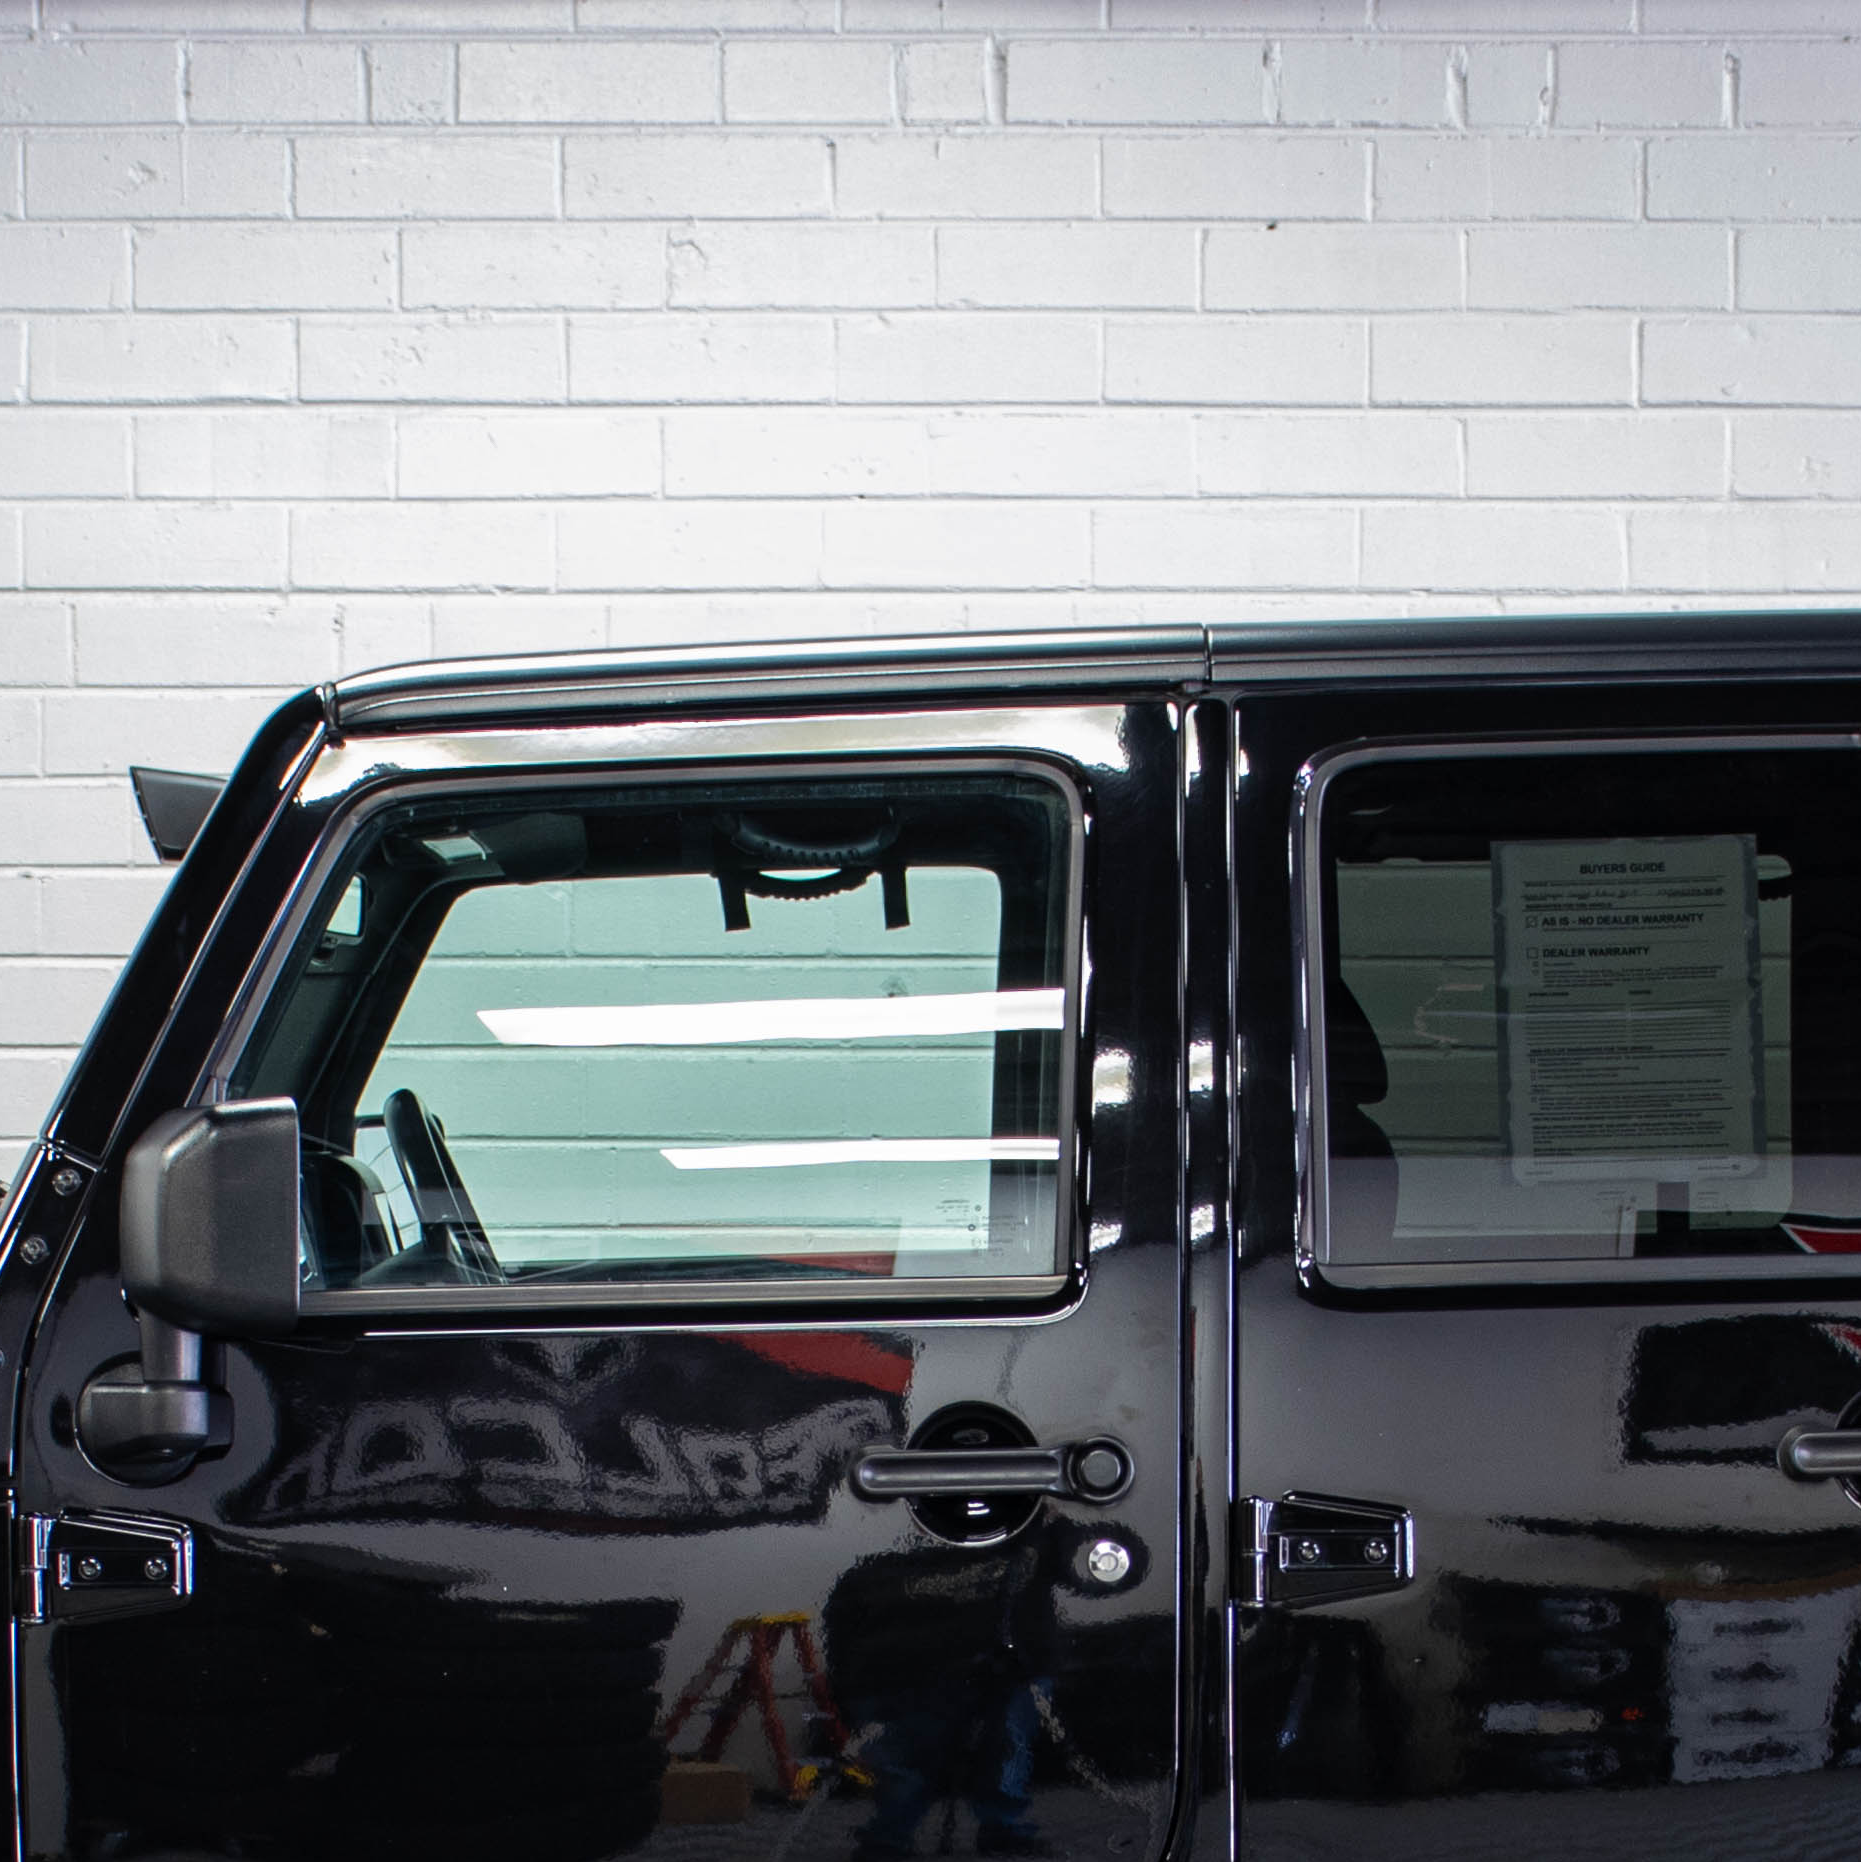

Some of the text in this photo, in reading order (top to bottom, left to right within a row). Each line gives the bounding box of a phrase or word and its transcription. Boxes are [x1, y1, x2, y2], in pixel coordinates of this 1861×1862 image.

[1579, 862, 1667, 874] BUYERS GUIDE
[1541, 916, 1557, 926] AS
[1559, 916, 1570, 926] IS
[1578, 915, 1594, 926] NO
[1597, 914, 1639, 925] DEALER
[1641, 912, 1705, 924] WARRANTY
[1542, 946, 1651, 958] DEALER WARRANTY
